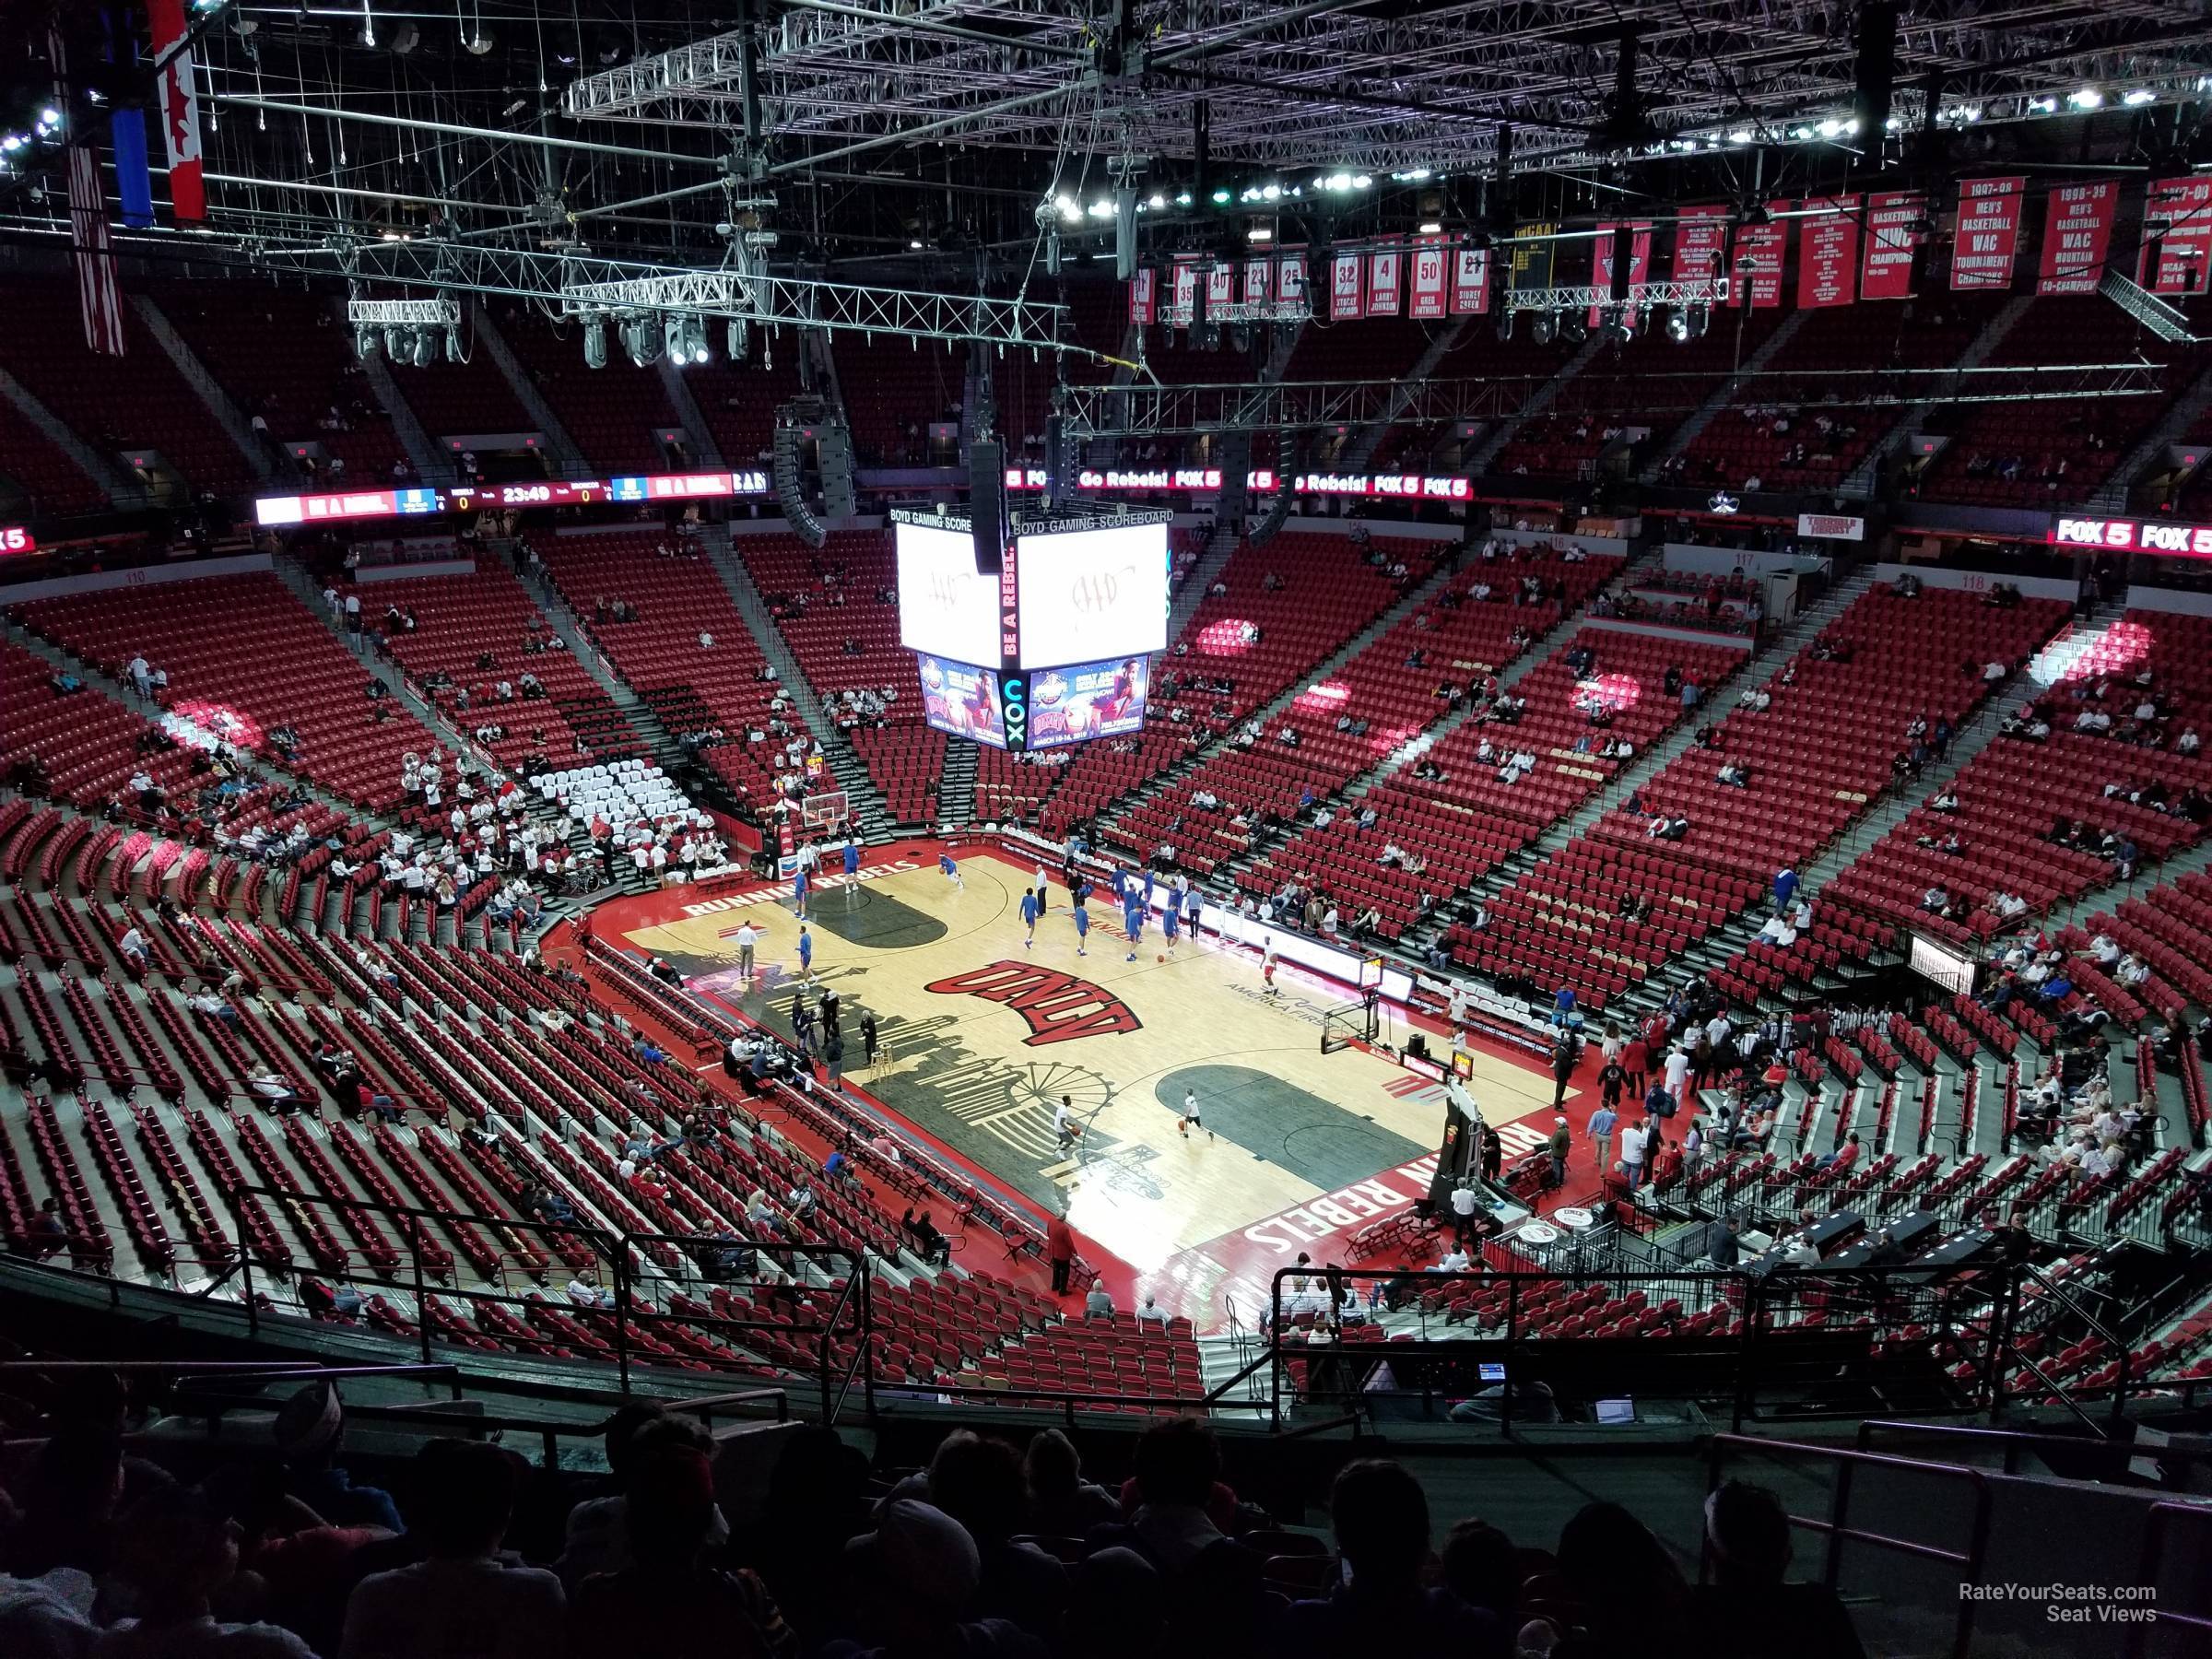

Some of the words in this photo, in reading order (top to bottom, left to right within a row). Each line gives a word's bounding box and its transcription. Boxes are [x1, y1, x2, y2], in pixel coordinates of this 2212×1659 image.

[1976, 201, 2002, 215] MEN'S
[2069, 203, 2092, 216] MEN'S
[1962, 218, 2011, 230] BASKETBALL
[2057, 218, 2100, 230] BASKETBALL
[1875, 228, 1912, 249] MWC
[1972, 234, 1998, 252] WAC
[2063, 233, 2091, 249] WAC
[1957, 255, 2009, 269] TOURNAMENT
[2055, 252, 2093, 264] MOUNTAIN
[1339, 265, 1355, 284] 32
[1381, 259, 1389, 277] 4
[1421, 262, 1437, 280] 50
[1181, 287, 1193, 301] 35
[1027, 470, 1046, 487] FO
[1079, 471, 1103, 487] Go
[1107, 470, 1168, 488] Rebels!
[1175, 470, 1205, 487] FOX
[1205, 470, 1221, 487] 5
[1256, 471, 1273, 488] 5
[1308, 474, 1367, 492] Rebels!
[1374, 476, 1403, 493] FOX
[1403, 477, 1418, 494] 5
[1424, 478, 1452, 496] FOX
[1453, 478, 1467, 497] 5
[459, 496, 468, 510] 0
[503, 486, 550, 502] 23:49
[582, 489, 590, 502] 0
[890, 509, 911, 524] BOYD
[912, 512, 943, 528] GAMING
[1014, 522, 1044, 535] BOYD
[1049, 516, 1095, 532] GAMING
[1100, 510, 1174, 529] SCOREBOARD
[6, 529, 26, 548] 5
[2056, 519, 2103, 545] FOX
[2106, 521, 2131, 546] 5
[2141, 524, 2191, 551] FOX
[2194, 527, 2212, 553] 5
[125, 571, 146, 584] 110
[1003, 547, 1017, 607] REBEL.
[1962, 574, 1984, 590] 118
[1004, 613, 1017, 628] A
[1004, 633, 1017, 655] BE
[1005, 679, 1026, 743] COX
[1033, 735, 1054, 747] MARCH
[812, 860, 921, 889] REBELS
[924, 959, 1144, 1047] UNLV
[1224, 983, 1290, 1011] AMERICA
[1244, 1179, 1411, 1253] REBELS
